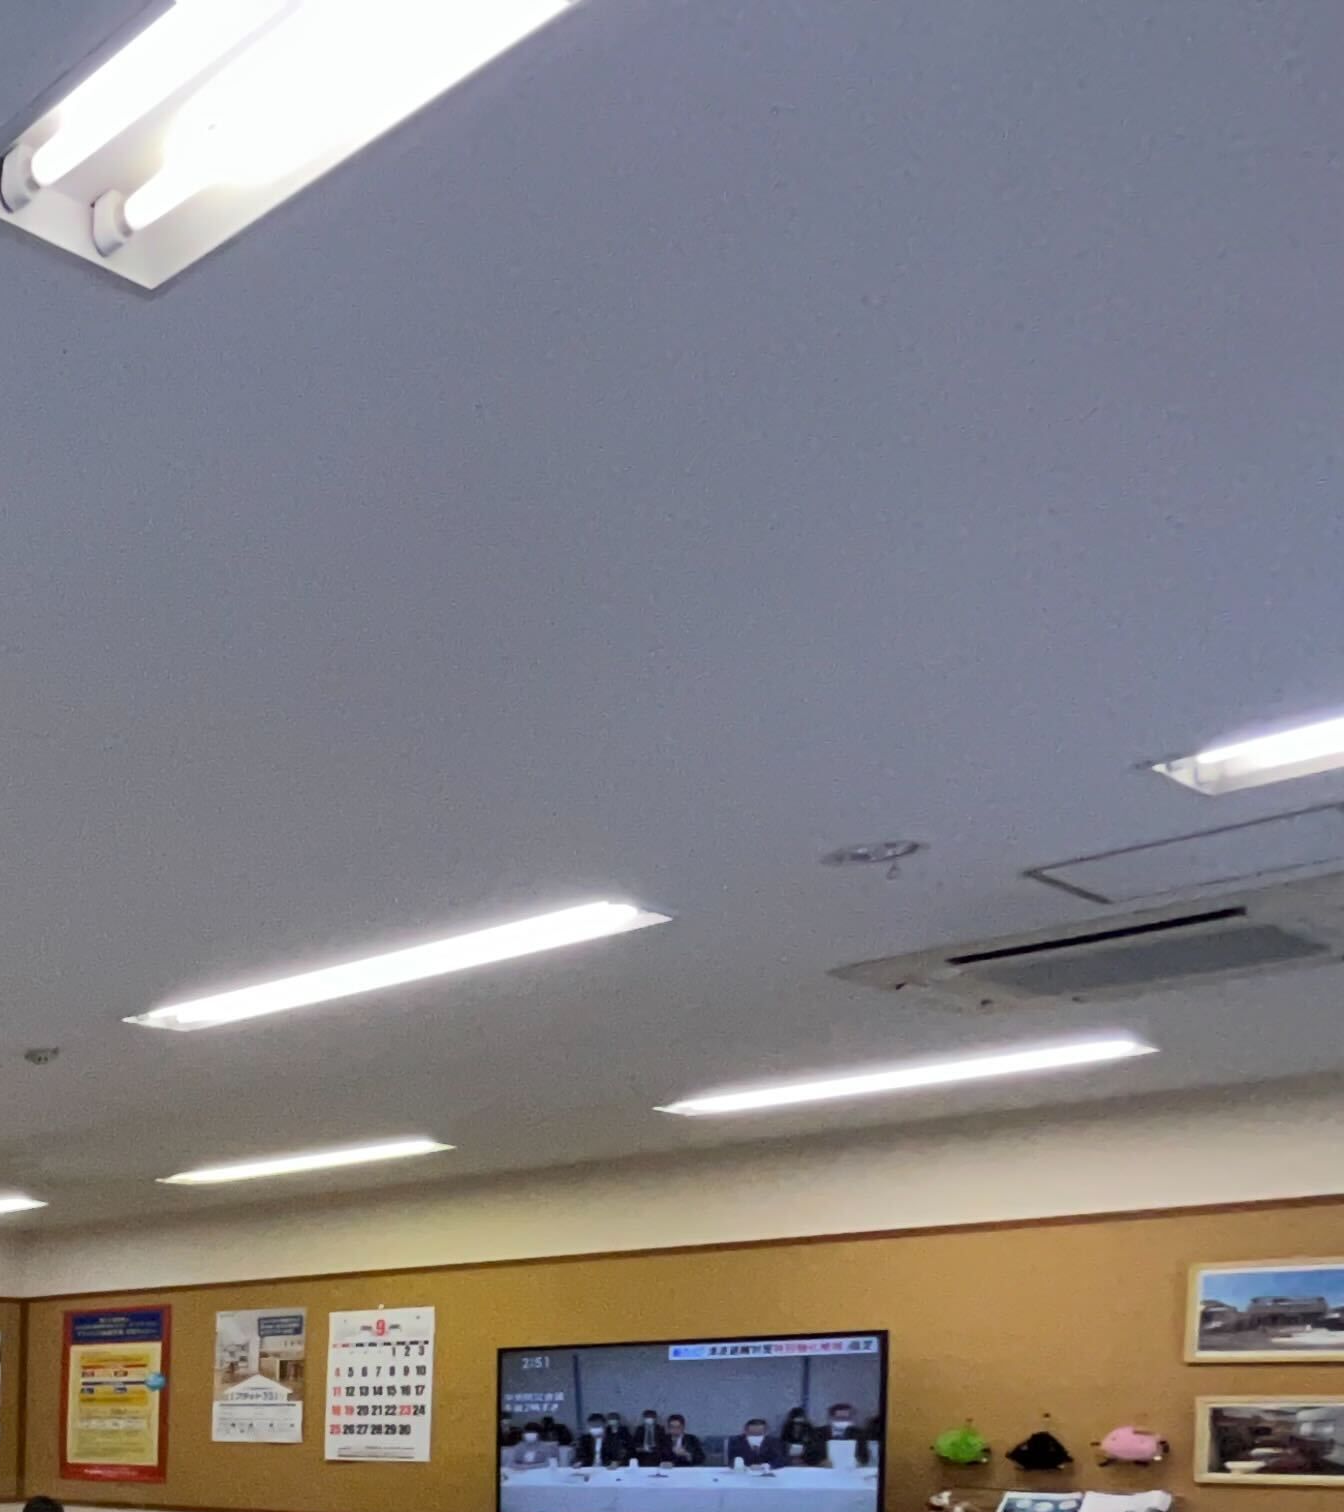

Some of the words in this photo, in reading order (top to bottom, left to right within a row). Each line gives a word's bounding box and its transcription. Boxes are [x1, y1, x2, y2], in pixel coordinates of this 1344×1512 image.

[376, 1319, 385, 1336] 9
[404, 1347, 410, 1356] 2
[419, 1346, 425, 1355] 3
[348, 1367, 354, 1378] 5
[376, 1366, 381, 1376] 7
[356, 1405, 369, 1415] 20
[371, 1405, 382, 1415] 21
[385, 1405, 396, 1415] 22
[356, 1425, 368, 1434] 27
